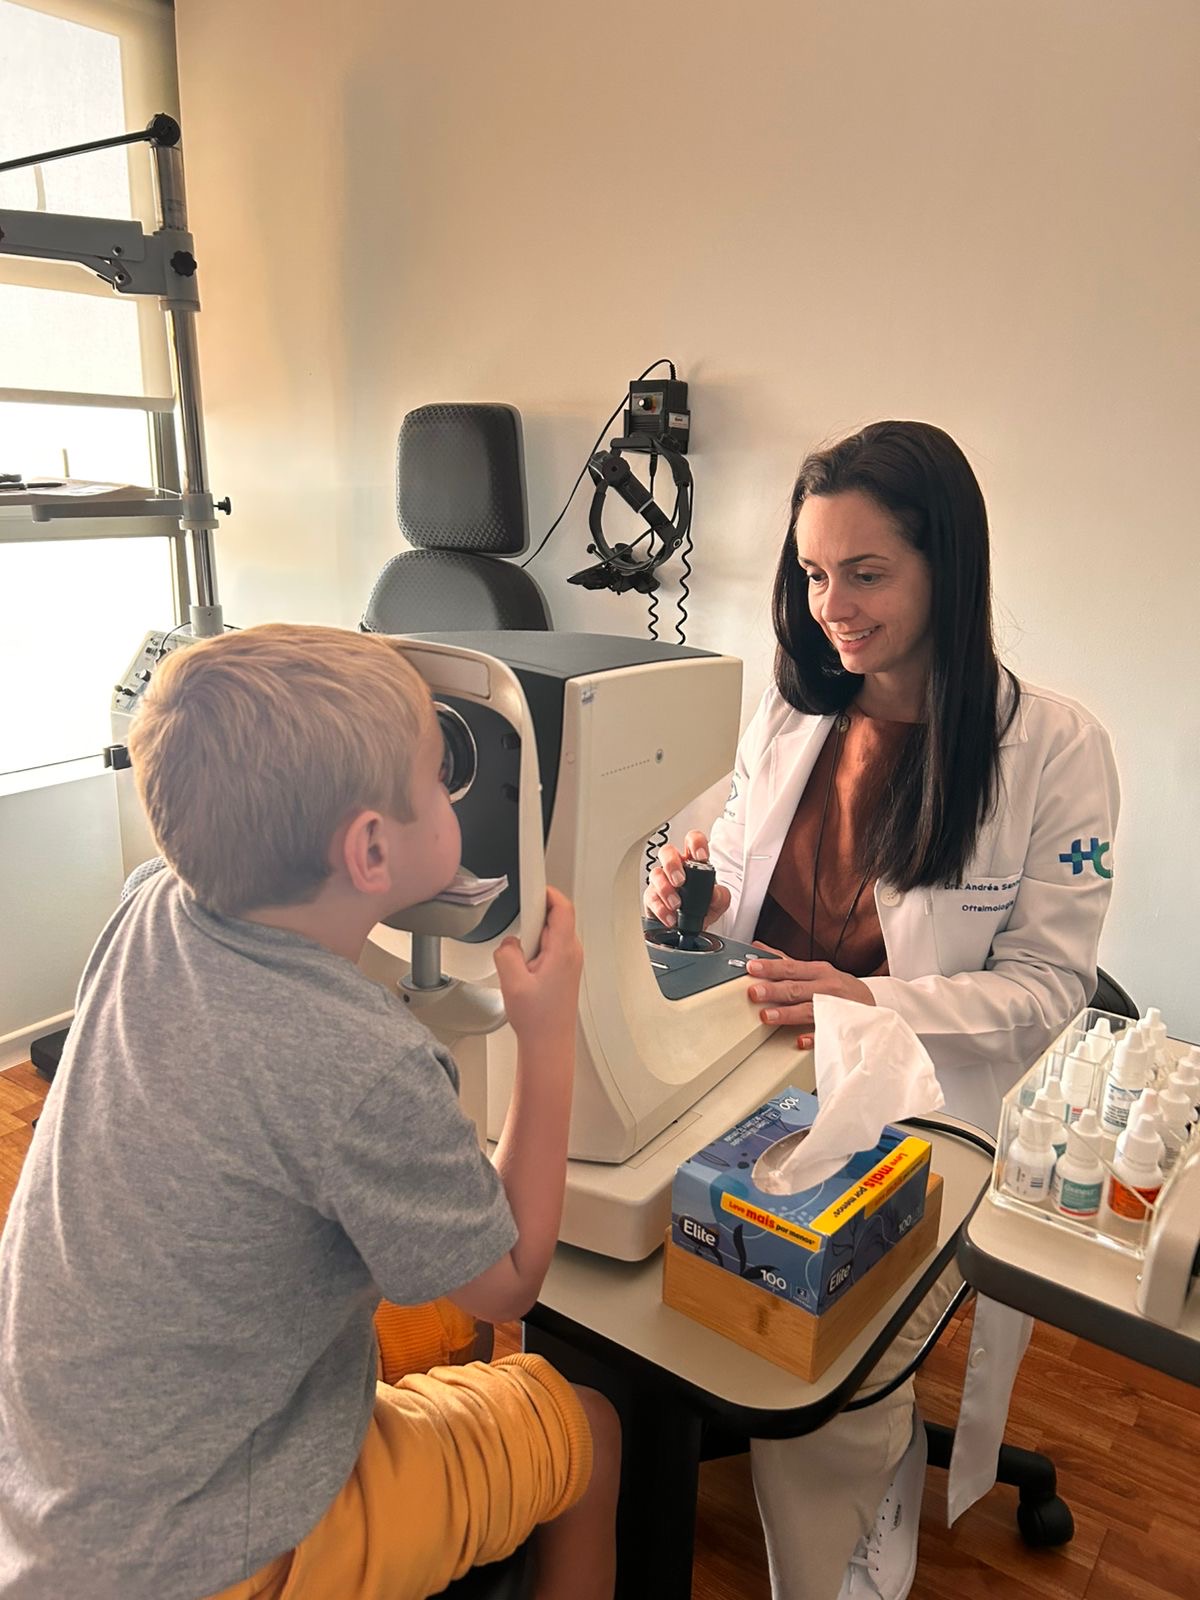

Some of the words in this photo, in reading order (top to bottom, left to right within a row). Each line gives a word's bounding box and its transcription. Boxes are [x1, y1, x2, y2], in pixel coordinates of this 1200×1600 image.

[965, 883, 999, 891] Andréa
[780, 1096, 800, 1110] 100
[891, 1152, 909, 1166] Leve
[864, 1164, 895, 1188] mais
[855, 1186, 868, 1199] por
[729, 1201, 746, 1213] Leve
[746, 1208, 775, 1229] mais
[776, 1224, 789, 1235] por
[899, 1214, 912, 1234] 100
[683, 1219, 716, 1246] Elite
[760, 1269, 787, 1290] 100
[829, 1264, 851, 1293] Elite
